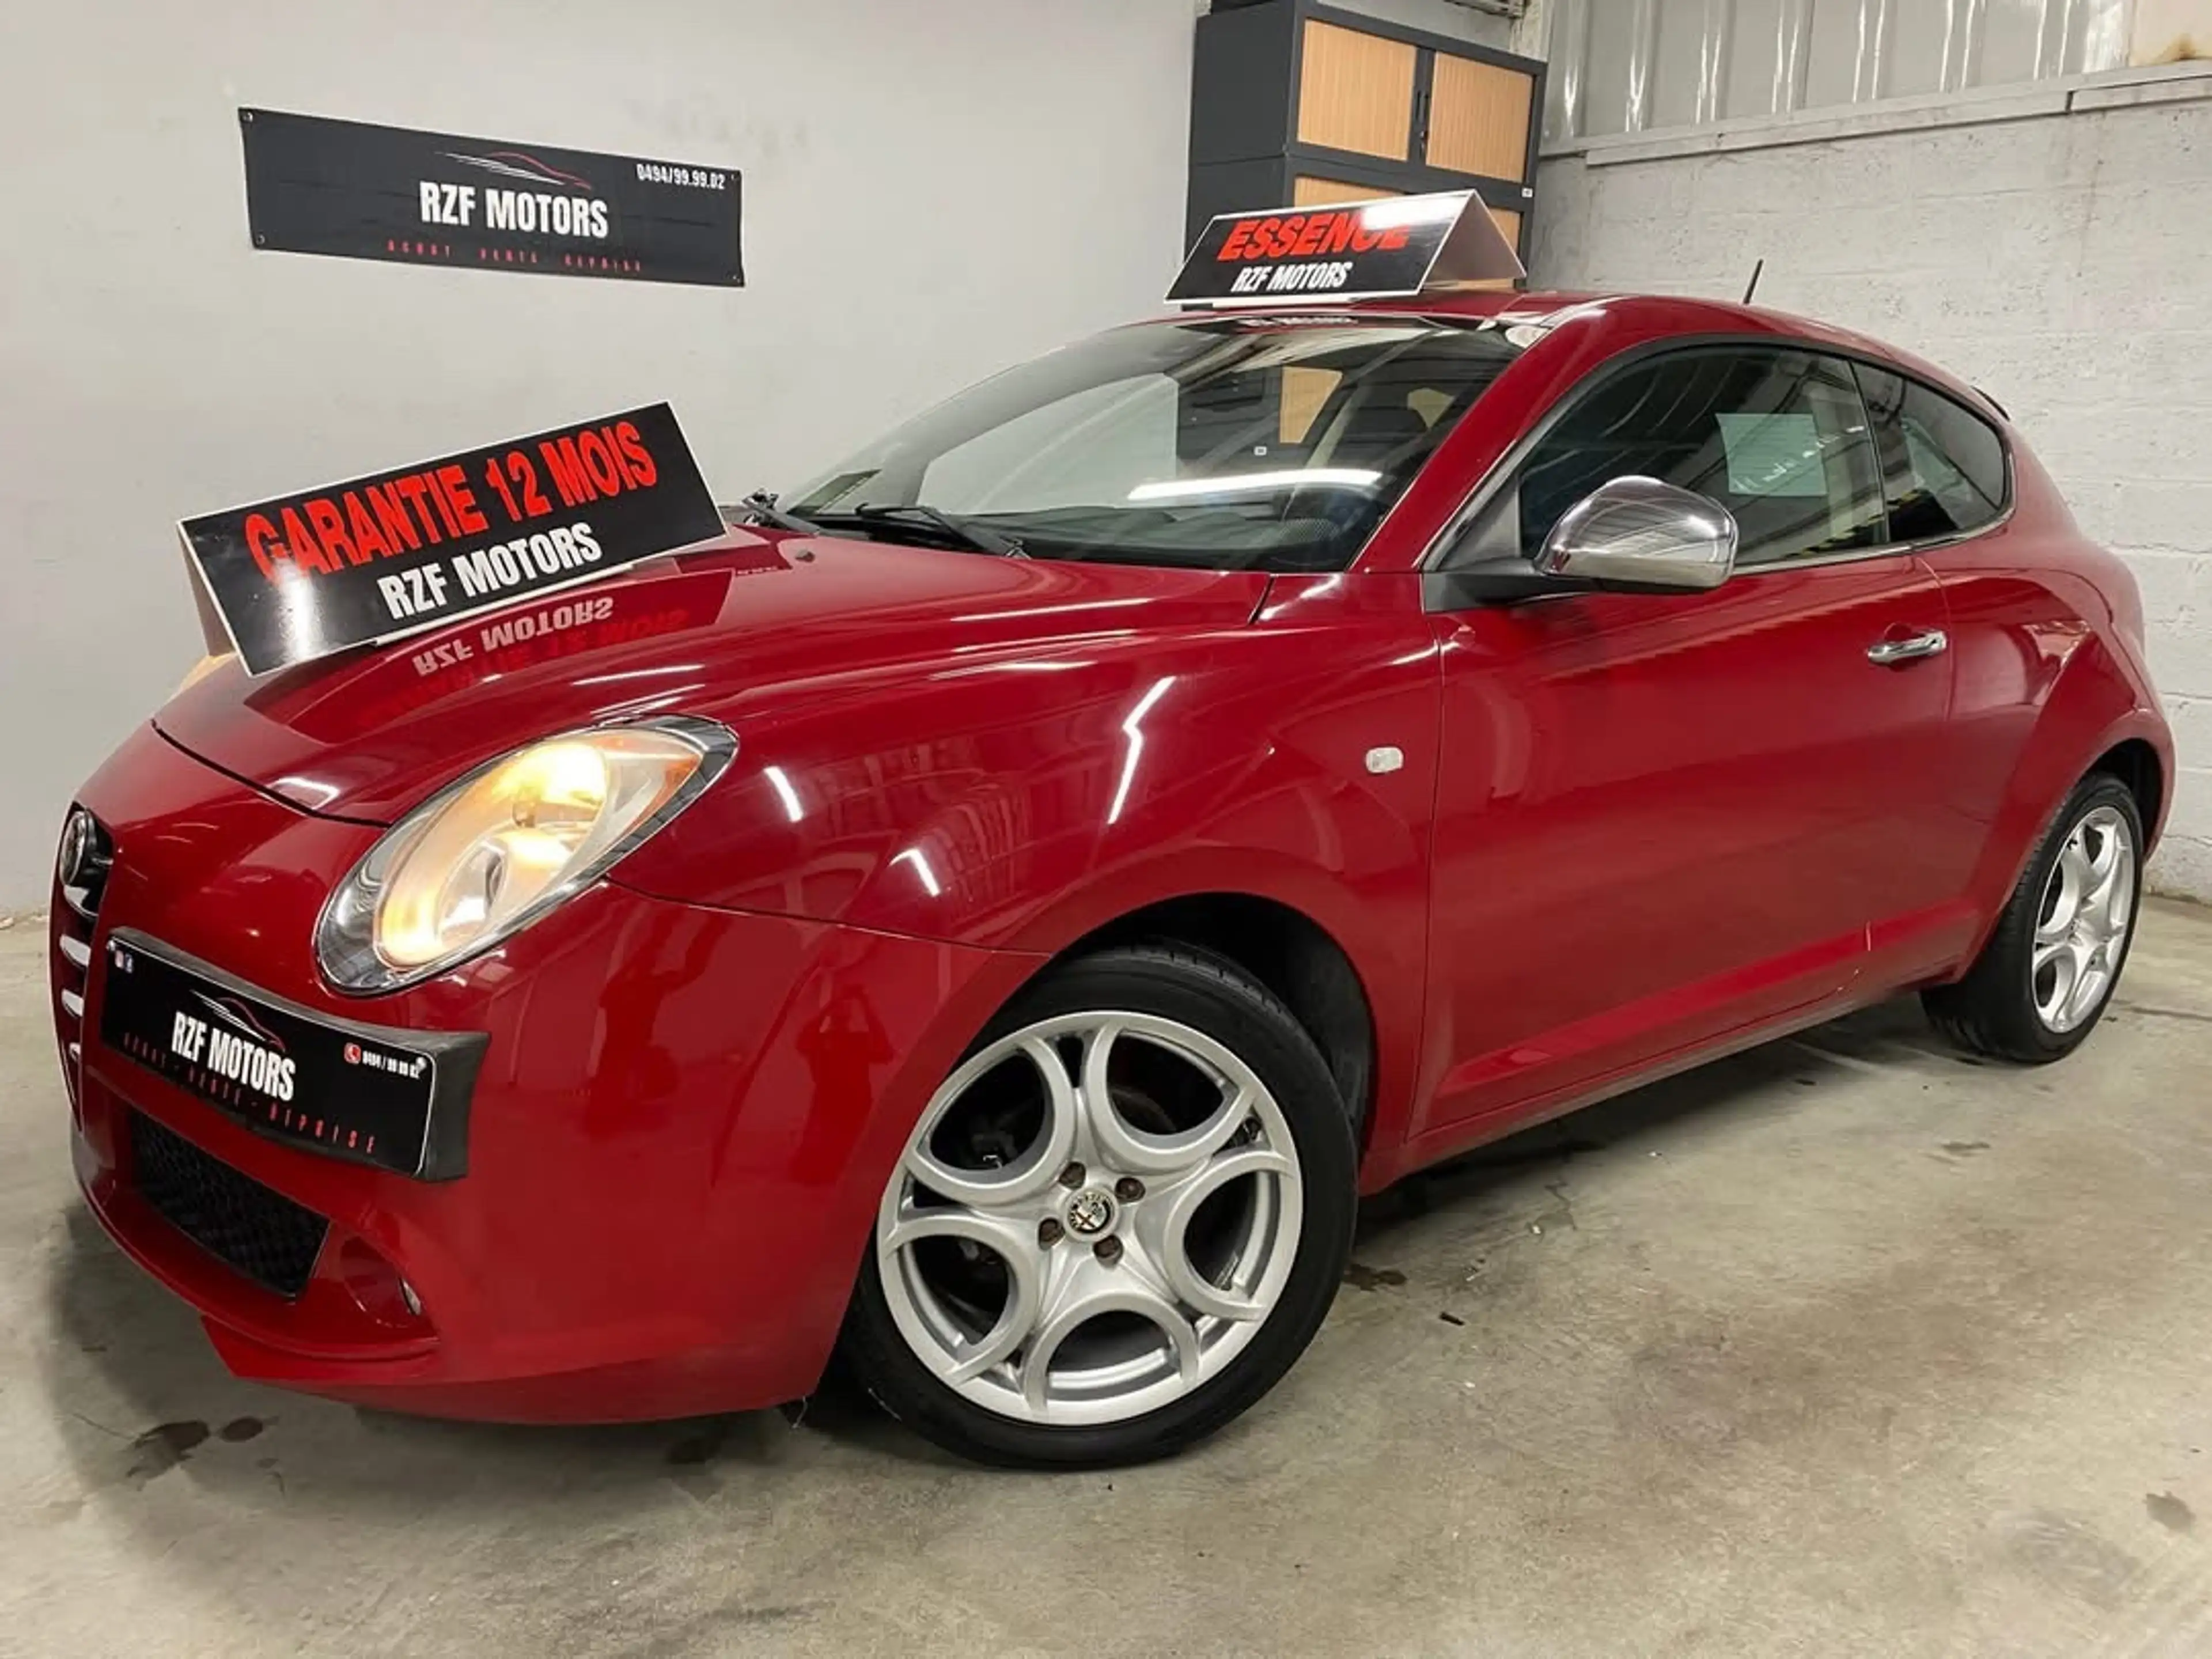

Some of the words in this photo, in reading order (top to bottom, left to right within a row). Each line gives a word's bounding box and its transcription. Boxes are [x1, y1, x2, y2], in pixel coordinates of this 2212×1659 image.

[419, 181, 477, 226] RZF
[486, 188, 608, 238] MOTORS
[1230, 266, 1271, 293] RZF
[1267, 262, 1353, 290] MOTORS
[245, 465, 488, 586] GARANTIE
[485, 451, 550, 521] 12
[540, 421, 658, 506] MOIS
[377, 563, 448, 620] RZF
[453, 522, 603, 597] MOTORS
[171, 1011, 207, 1063] RZF
[207, 1028, 296, 1102] MOTORS
